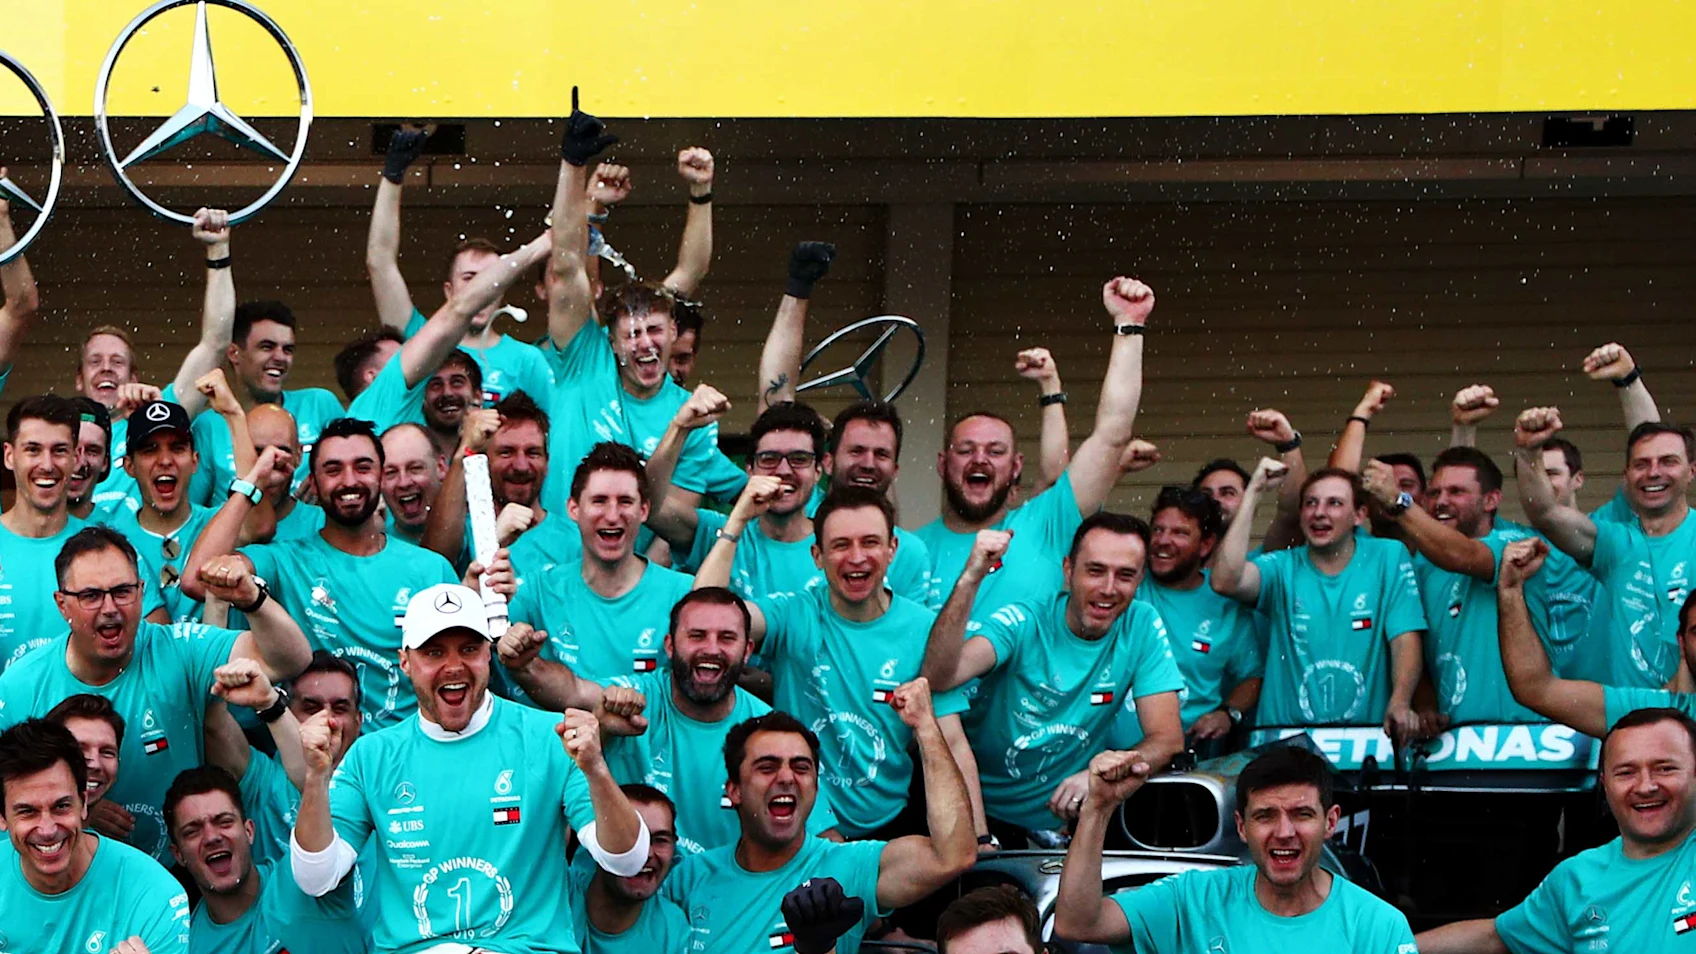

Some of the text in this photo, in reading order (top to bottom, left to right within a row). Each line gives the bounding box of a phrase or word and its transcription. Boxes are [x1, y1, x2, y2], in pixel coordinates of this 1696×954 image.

[345, 645, 393, 670] WINNERS
[403, 820, 424, 832] UBS
[423, 856, 498, 884] GP WINNERS
